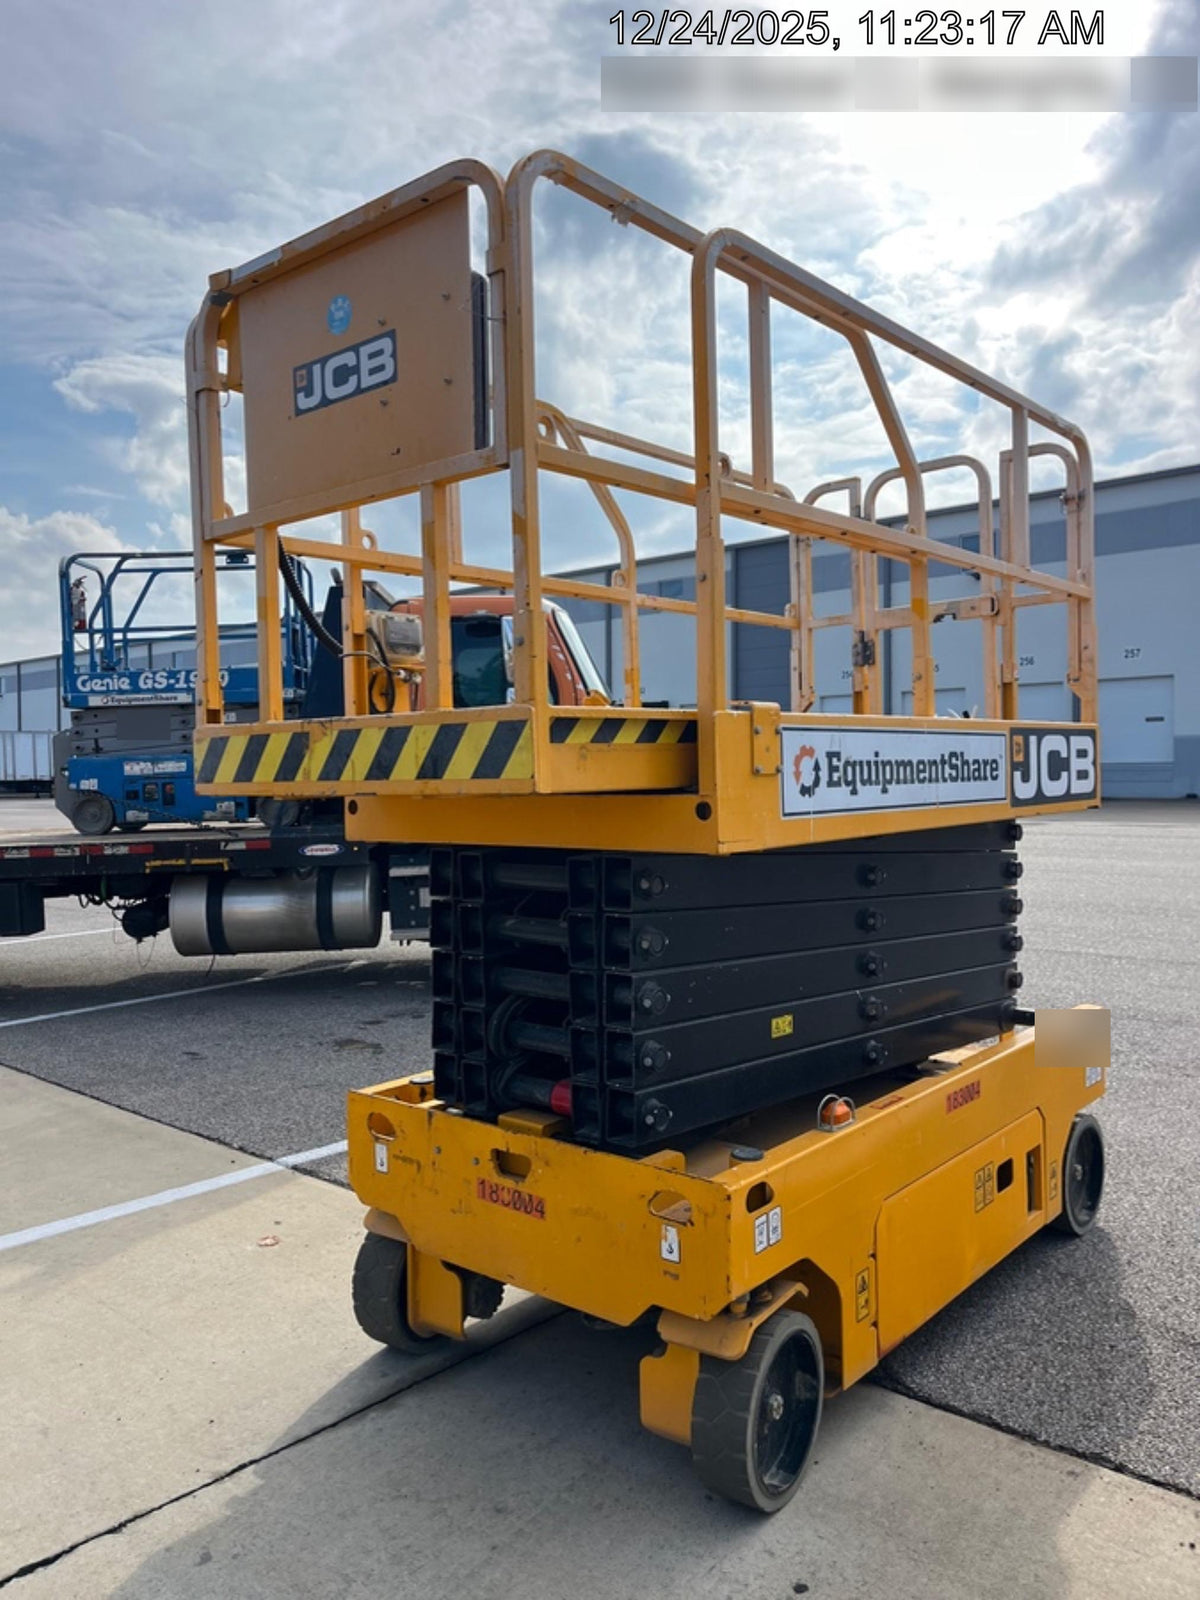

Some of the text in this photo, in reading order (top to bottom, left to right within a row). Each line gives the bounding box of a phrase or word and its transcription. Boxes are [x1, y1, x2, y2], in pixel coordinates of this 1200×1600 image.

[297, 337, 395, 410] JCB
[1124, 648, 1141, 659] 257
[76, 670, 229, 692] Genie GS-190
[825, 750, 999, 796] EquipmentShare
[1013, 734, 1095, 800] JCB
